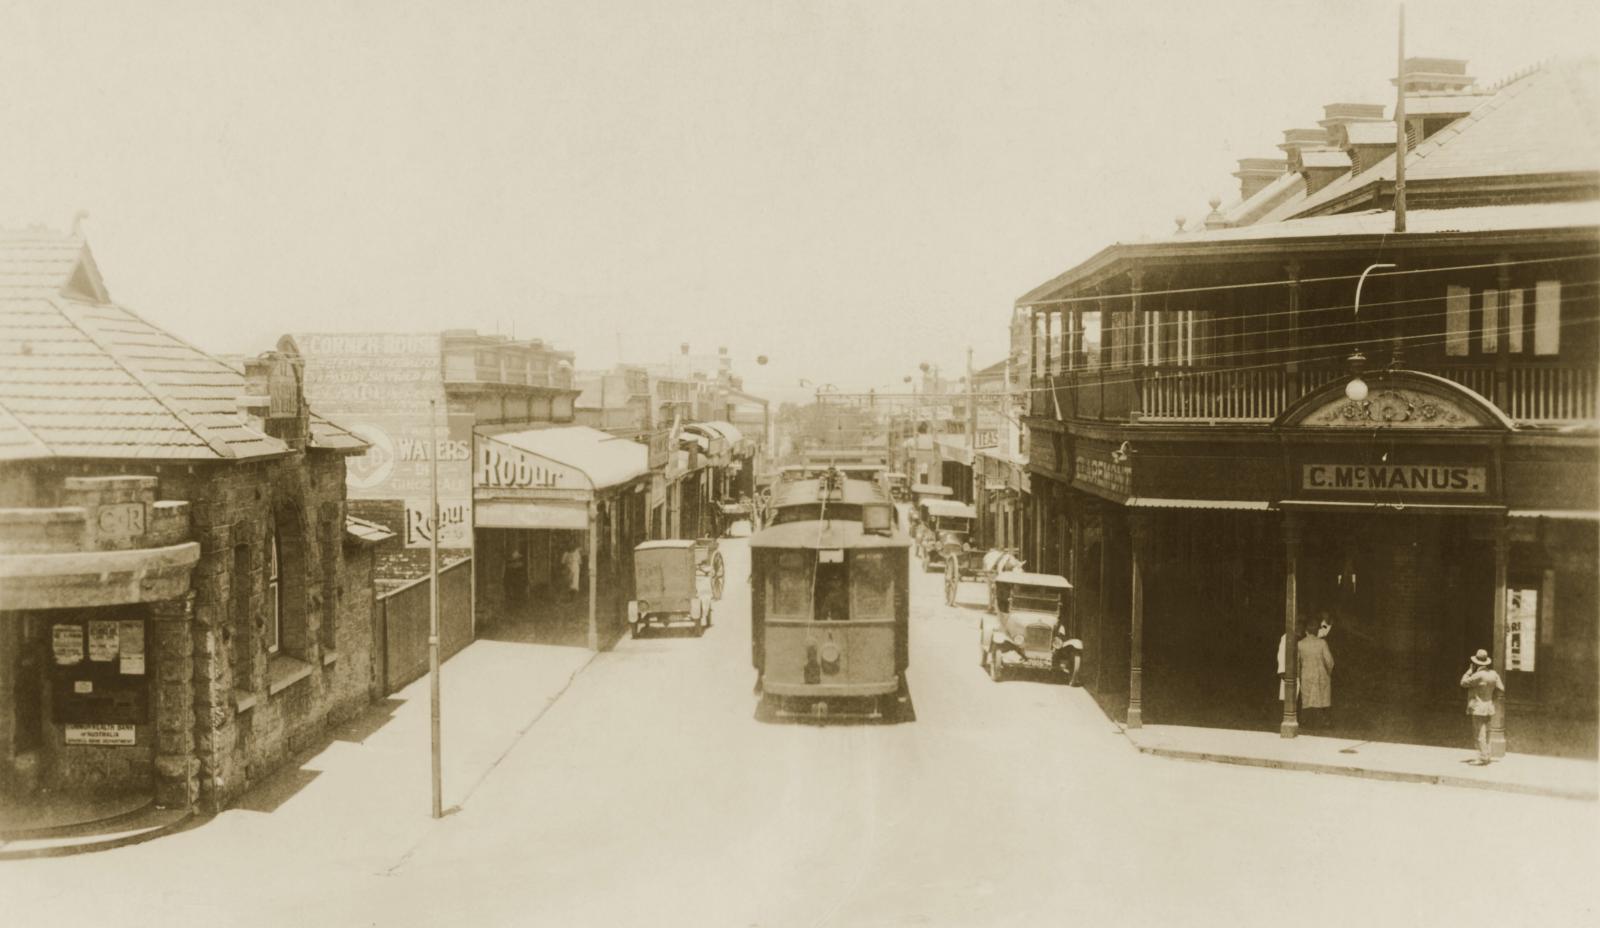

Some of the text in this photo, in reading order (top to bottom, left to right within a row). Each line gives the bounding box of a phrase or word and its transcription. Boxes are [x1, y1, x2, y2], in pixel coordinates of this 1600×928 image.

[310, 335, 379, 354] CORNER
[397, 439, 471, 462] WATERS
[478, 446, 562, 488] Robur
